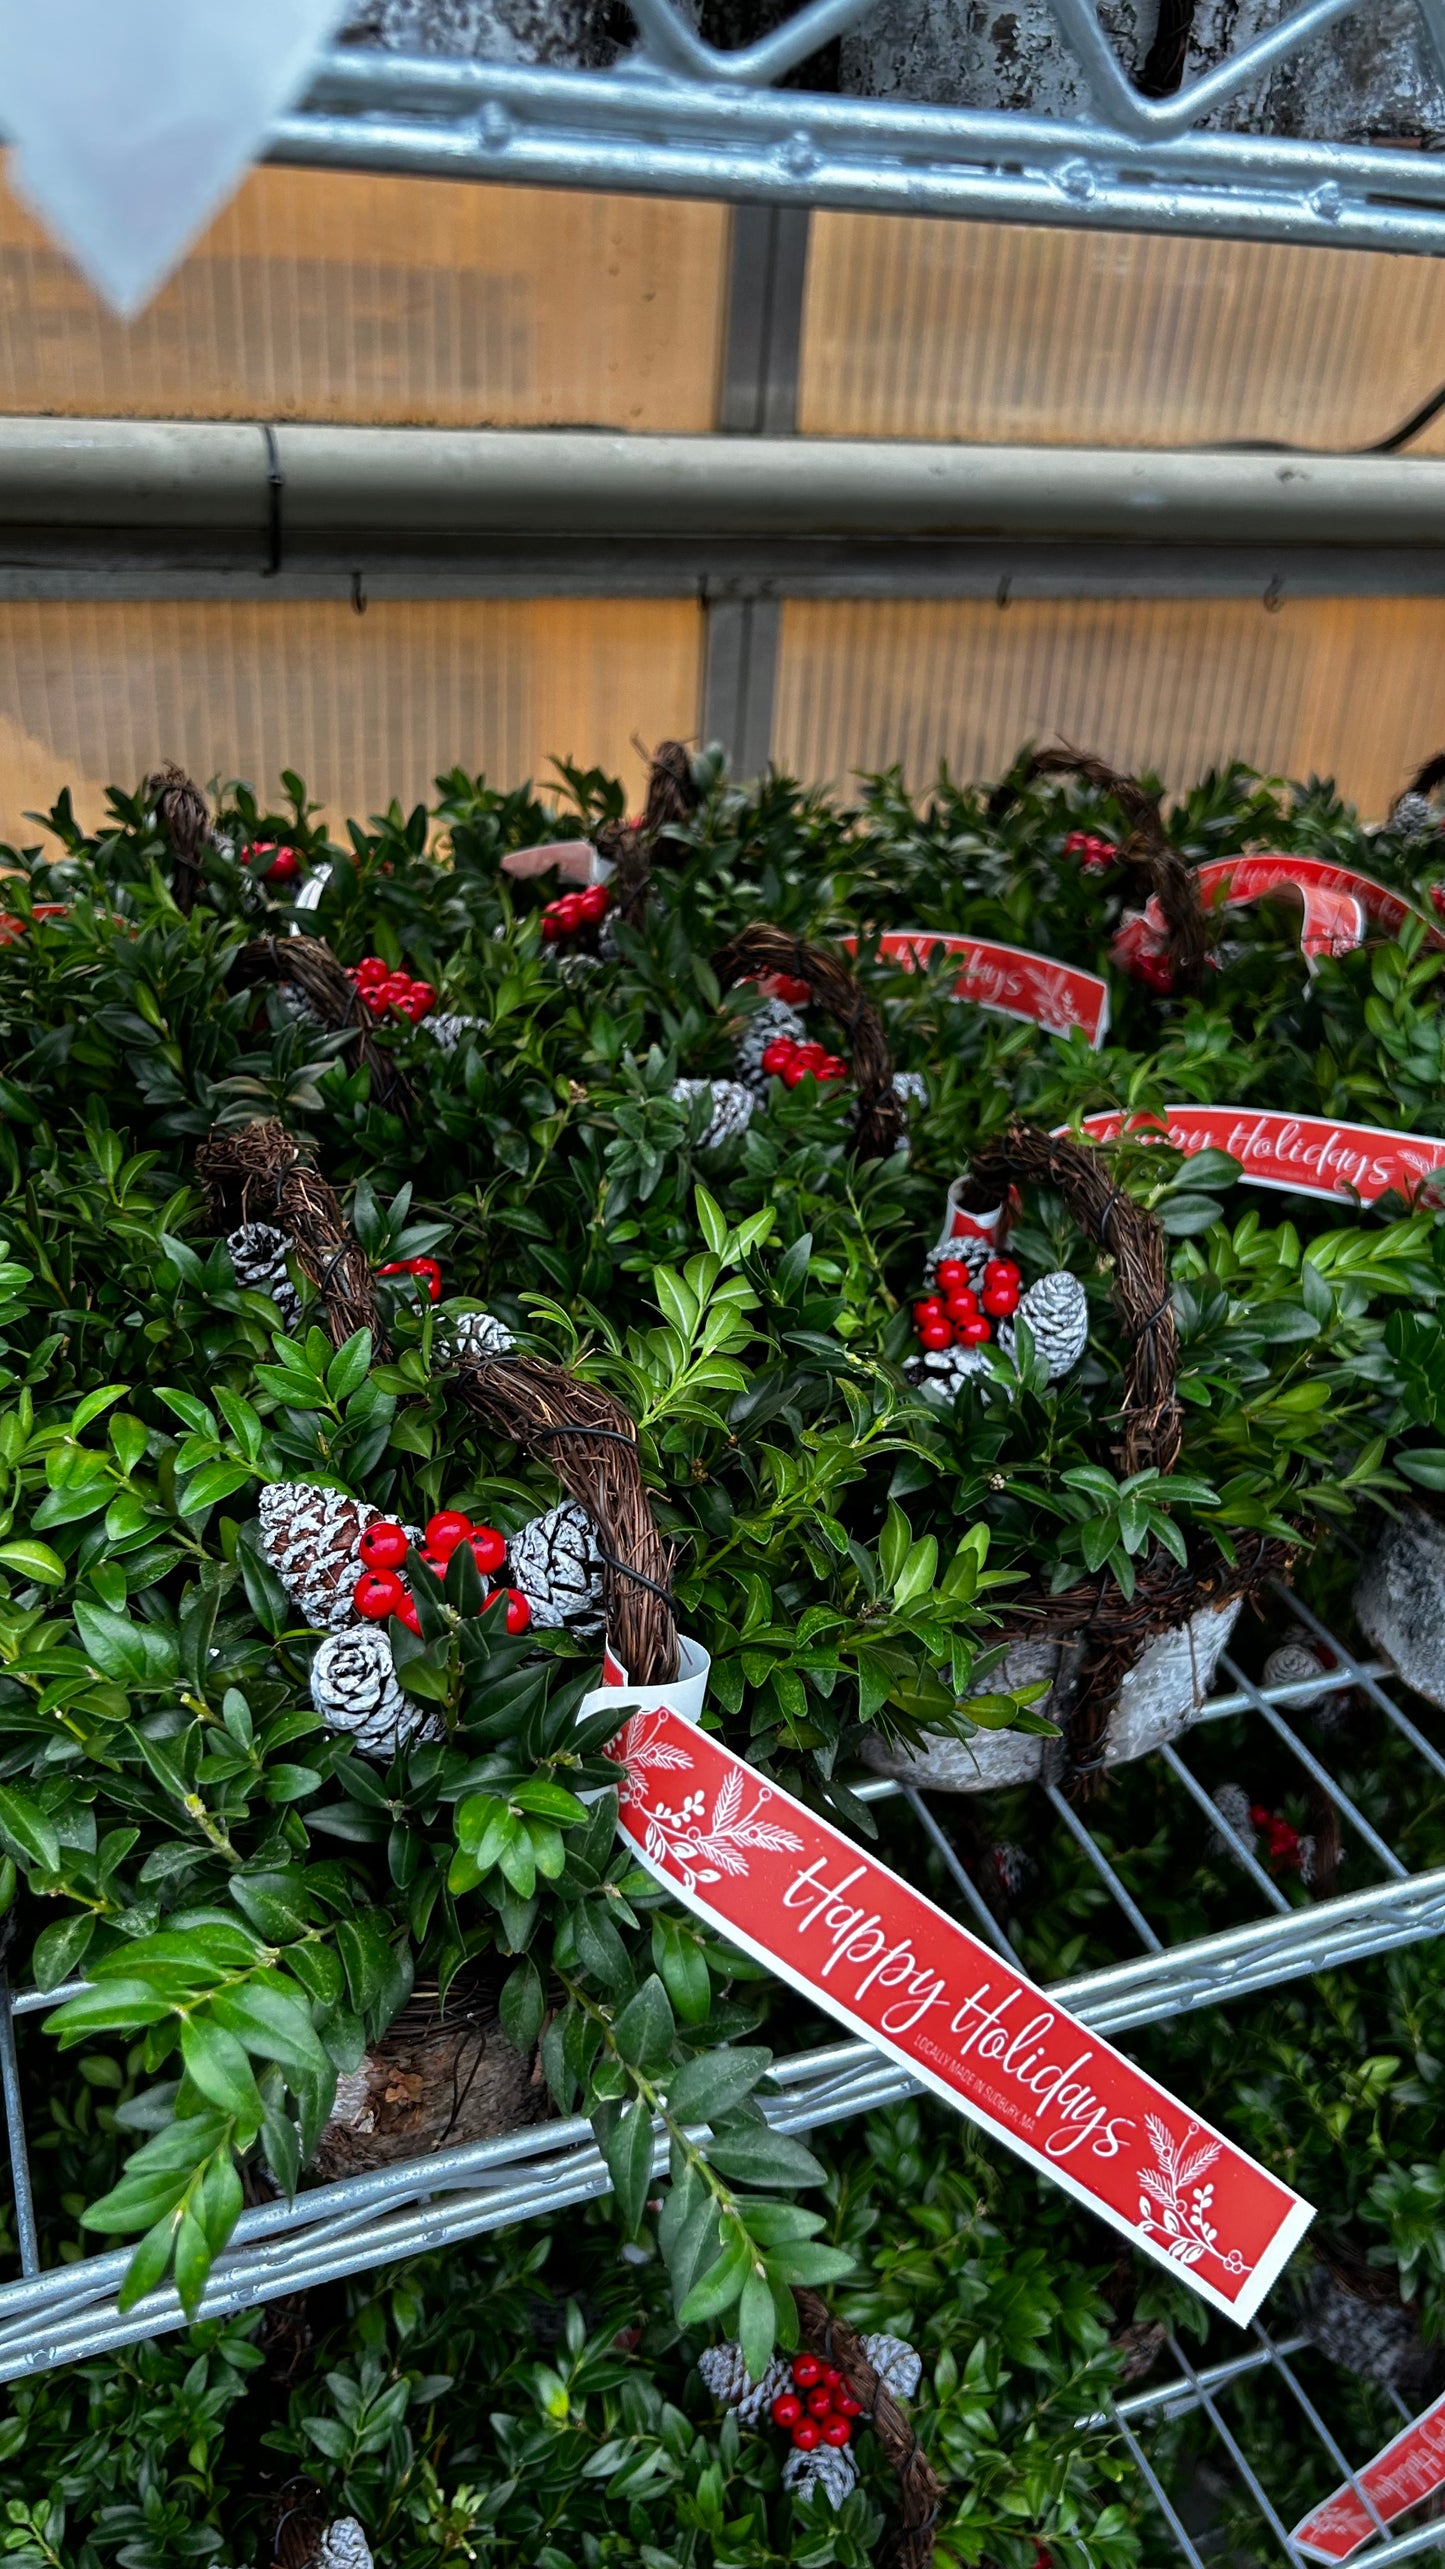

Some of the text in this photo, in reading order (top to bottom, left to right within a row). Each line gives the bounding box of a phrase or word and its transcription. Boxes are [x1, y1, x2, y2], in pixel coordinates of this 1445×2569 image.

[1226, 1117, 1397, 1192] Holidays
[782, 1856, 1136, 2156] Happy Holidays
[913, 2033, 950, 2066] LOCALLY
[948, 2059, 976, 2087] MADE
[975, 2079, 987, 2094] IN
[1019, 2113, 1036, 2131] MA
